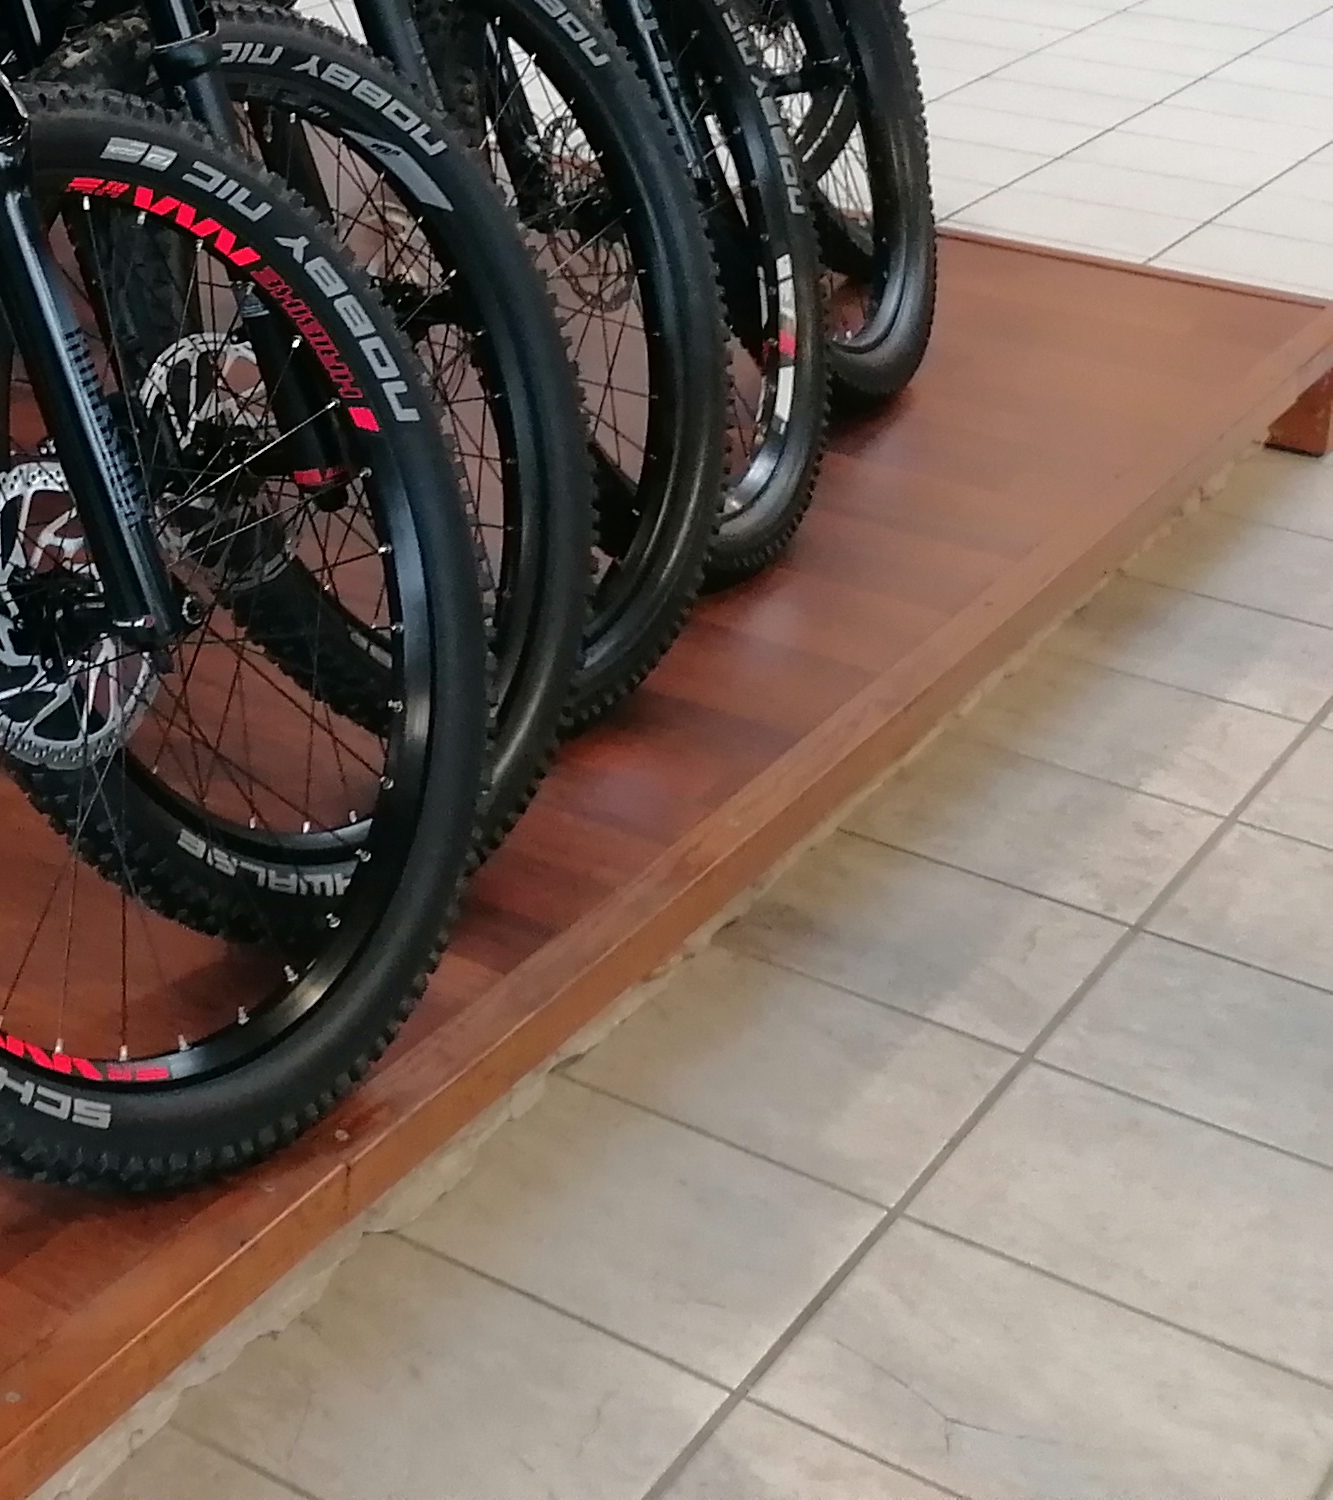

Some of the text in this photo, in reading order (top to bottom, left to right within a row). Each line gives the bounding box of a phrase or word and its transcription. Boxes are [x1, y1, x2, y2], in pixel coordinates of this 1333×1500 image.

[290, 54, 449, 157] NOBBY
[182, 160, 273, 223] NIC
[274, 235, 421, 423] NOBBY
[177, 828, 352, 897] HWALBE
